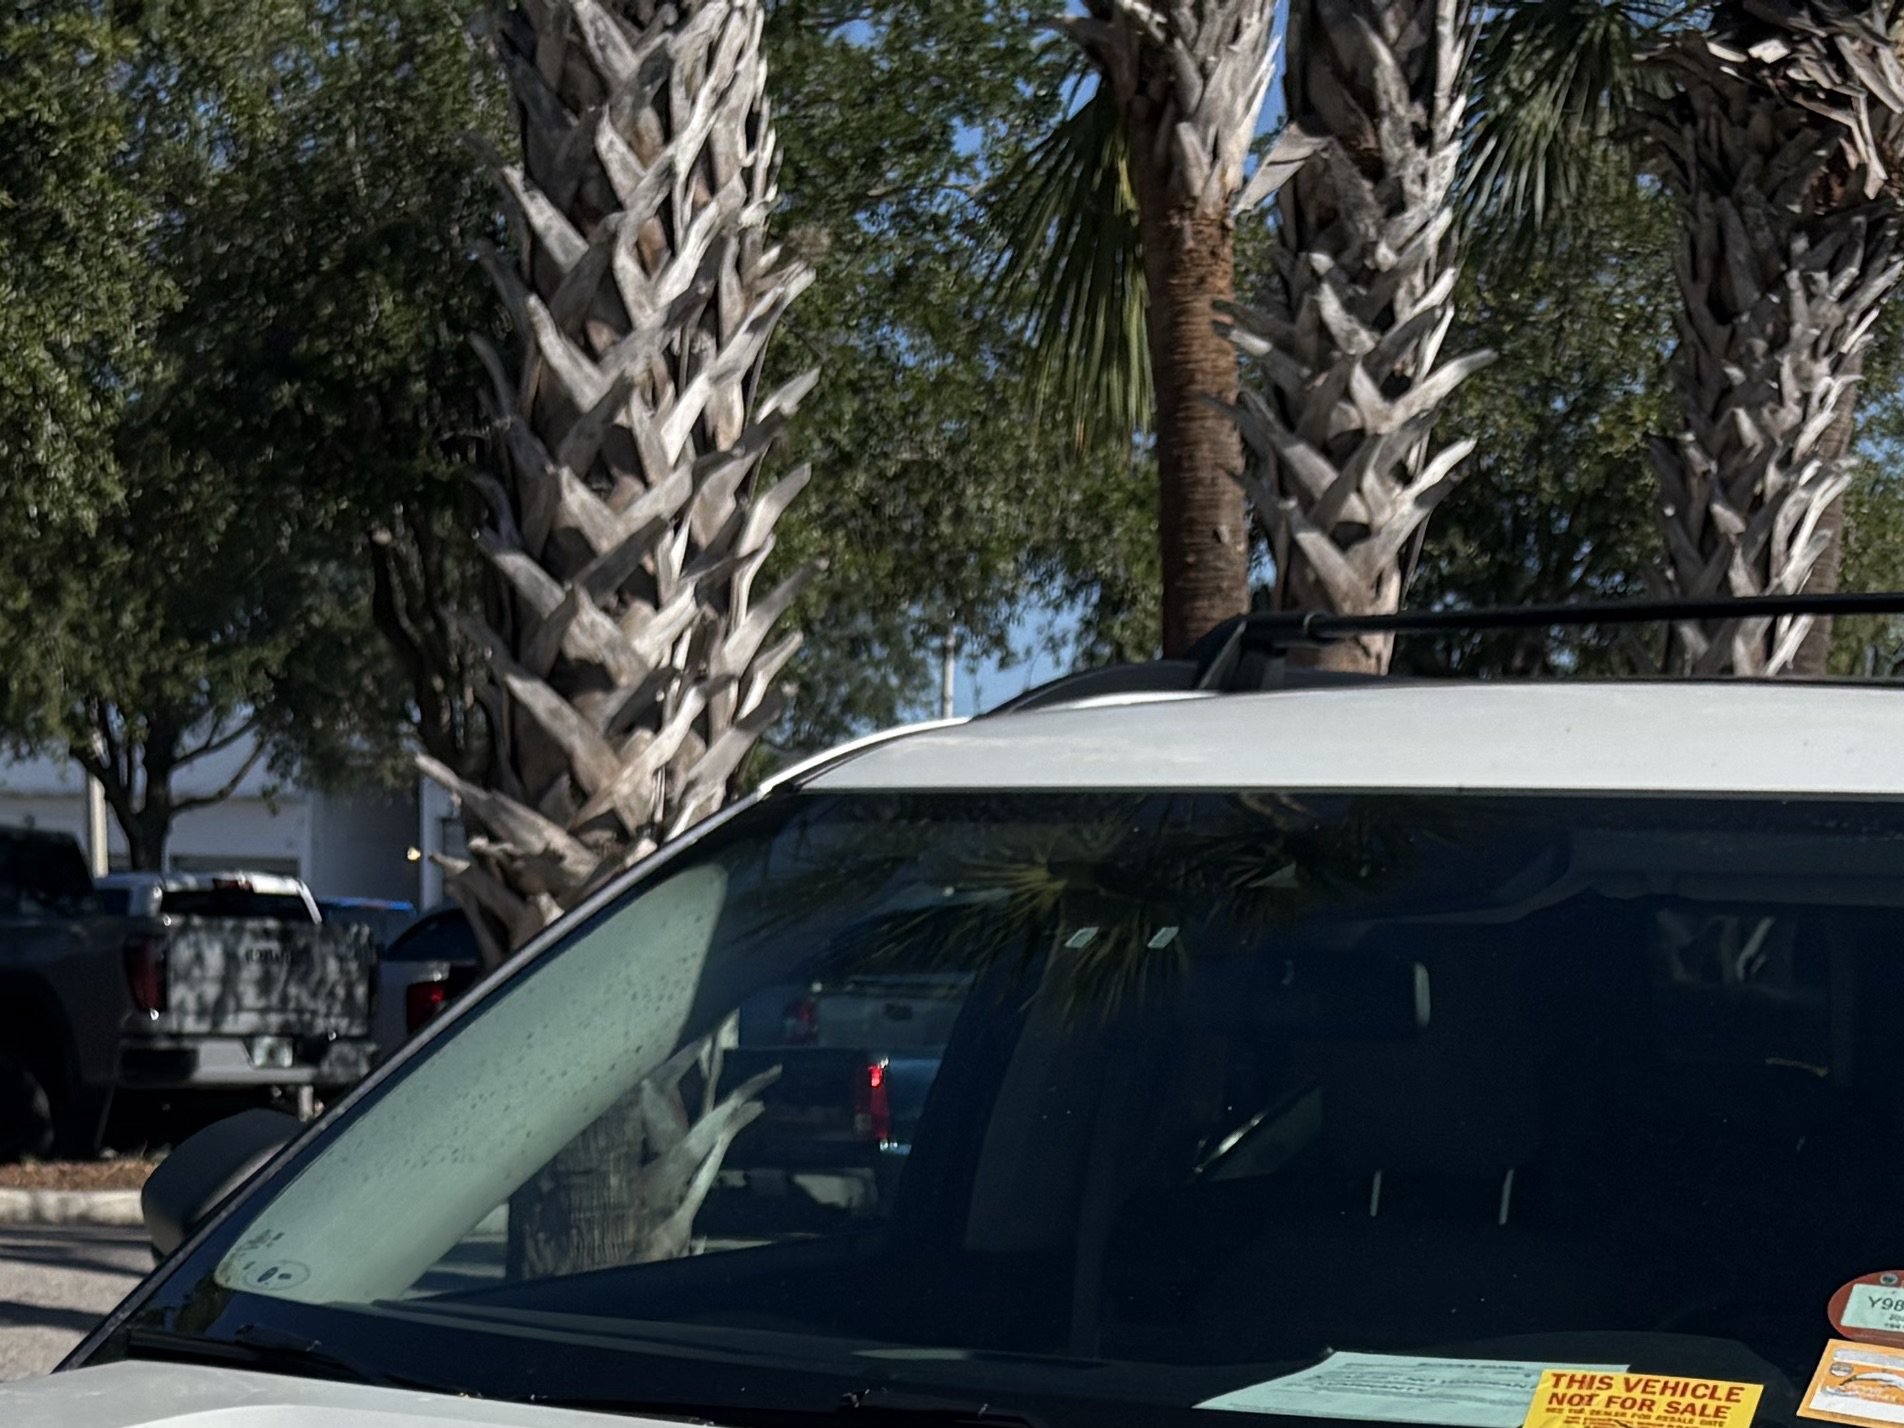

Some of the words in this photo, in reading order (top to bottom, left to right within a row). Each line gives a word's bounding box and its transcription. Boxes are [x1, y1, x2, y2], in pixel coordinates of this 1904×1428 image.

[1550, 1372, 1614, 1391] THIS
[1623, 1376, 1745, 1403] VEHICLE
[1547, 1392, 1599, 1407] NOT
[1605, 1395, 1654, 1412] FOR
[1663, 1400, 1731, 1419] SALE
